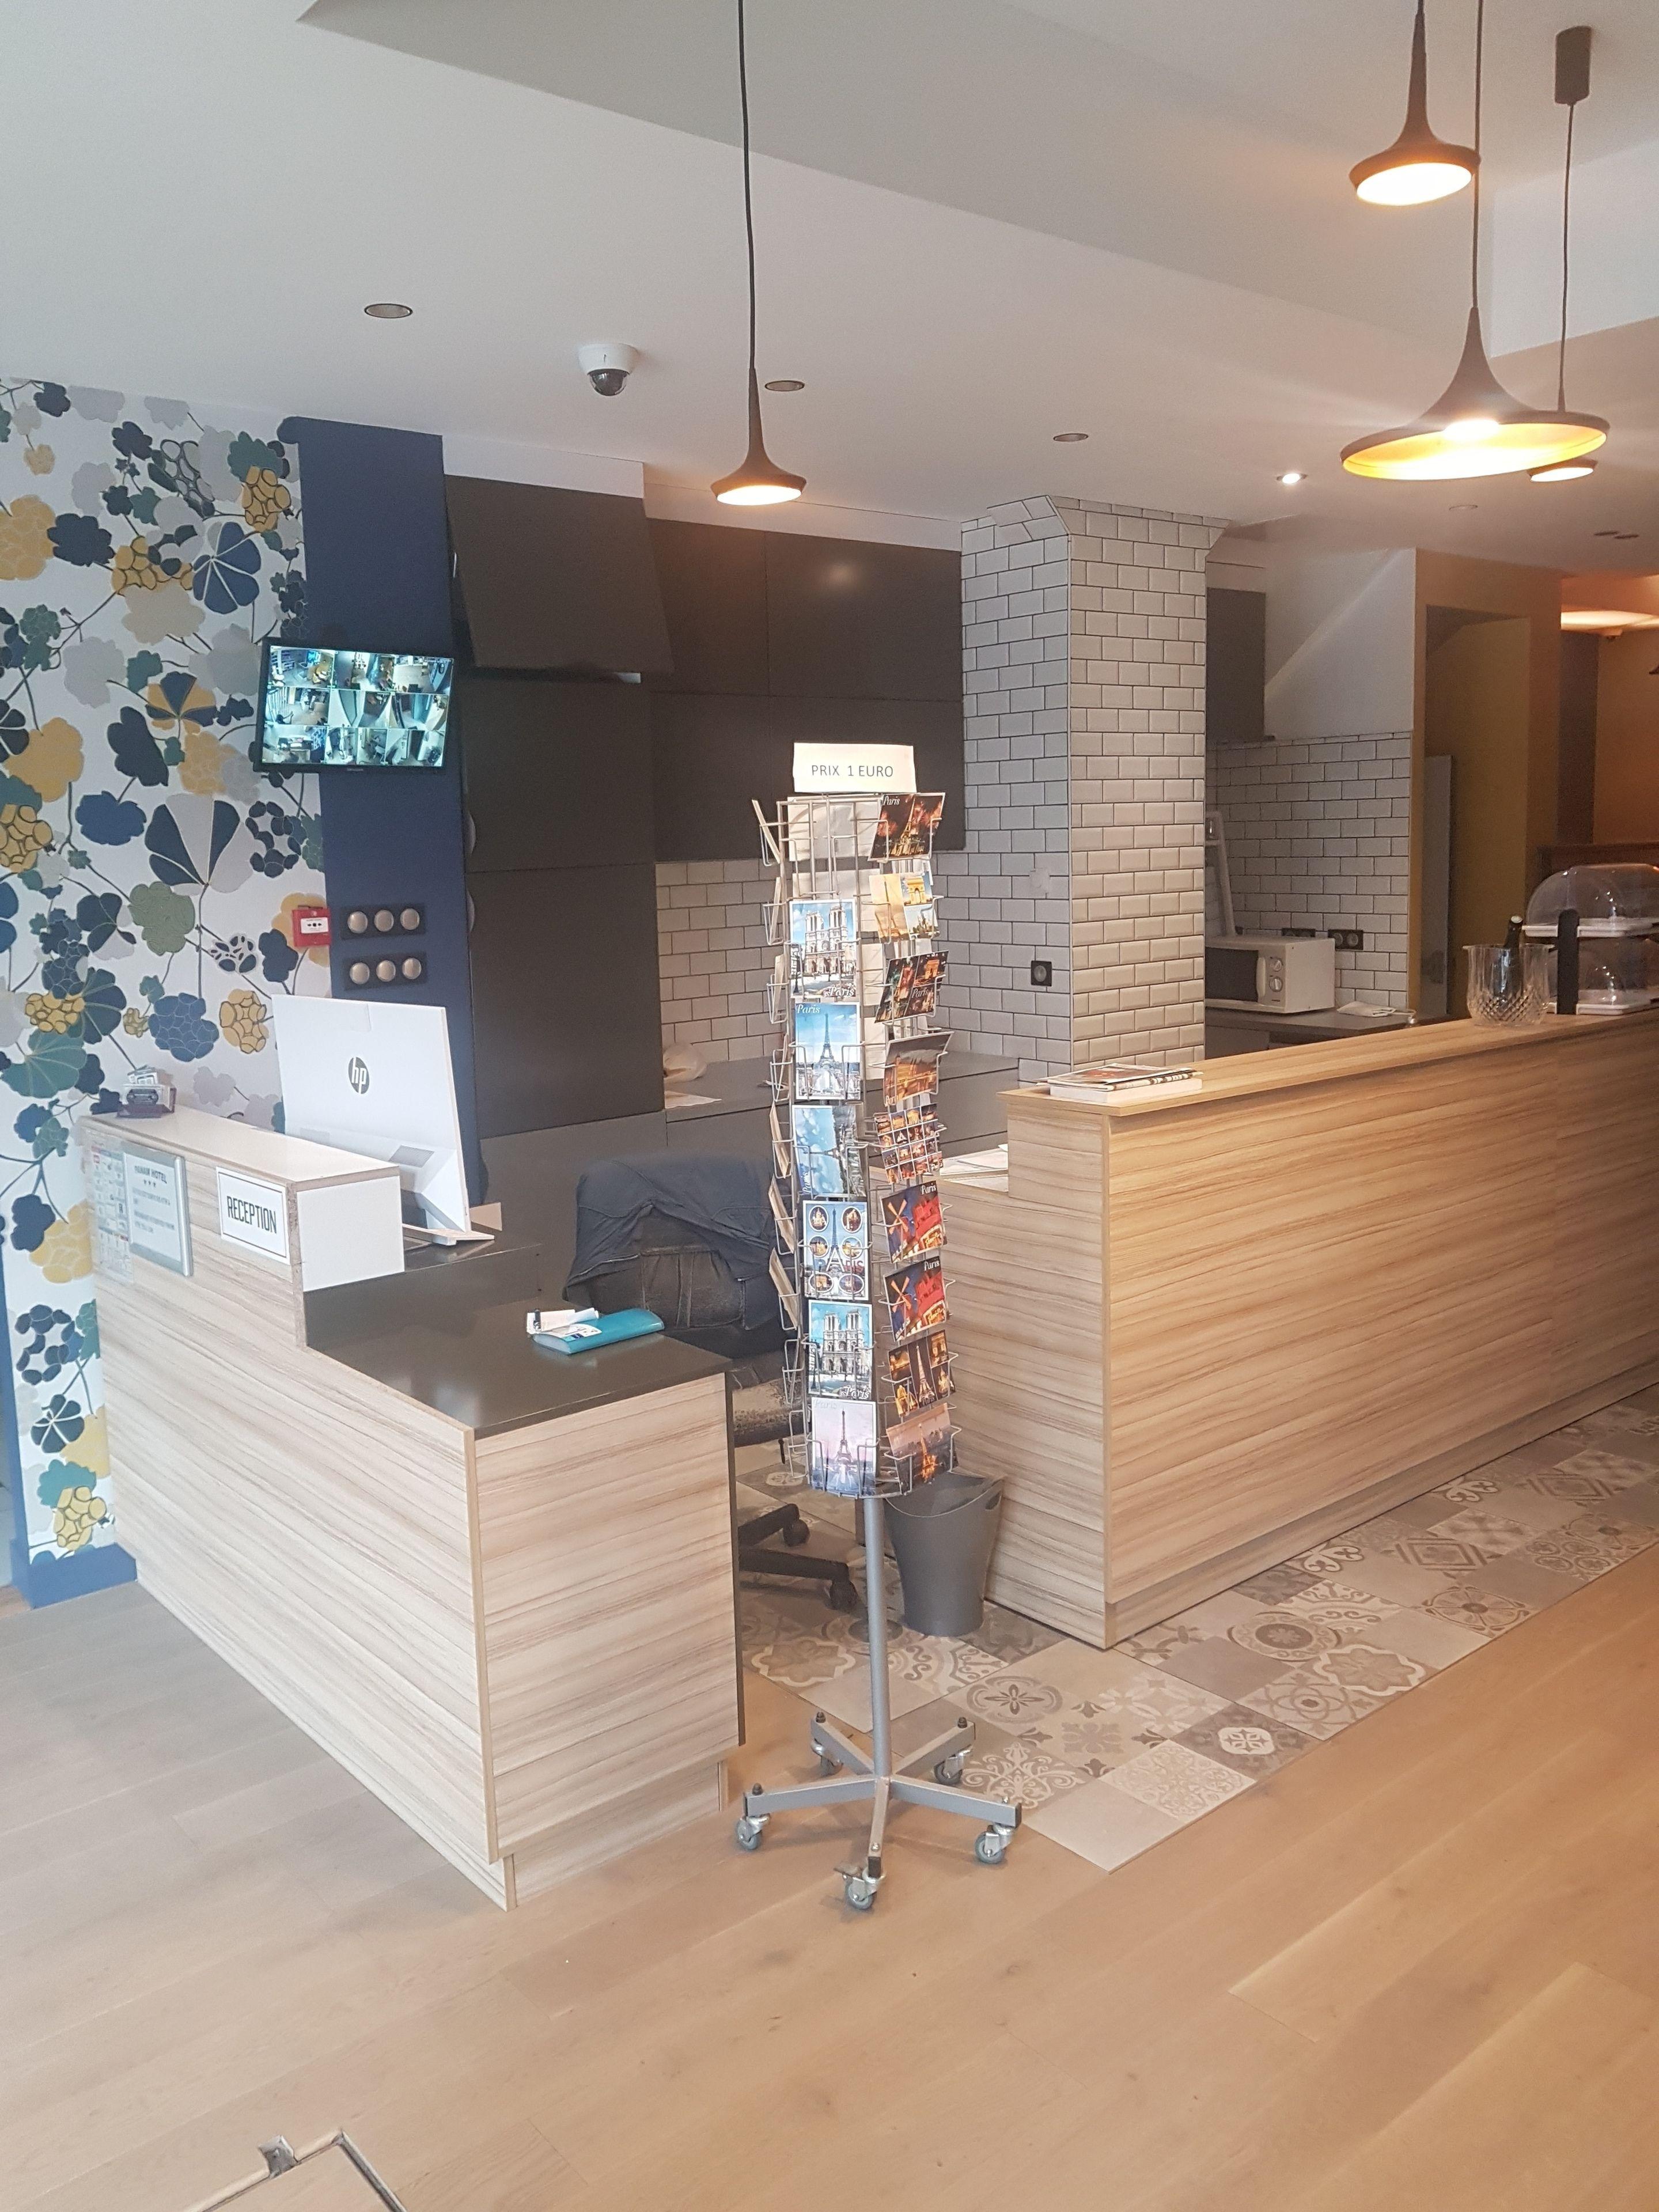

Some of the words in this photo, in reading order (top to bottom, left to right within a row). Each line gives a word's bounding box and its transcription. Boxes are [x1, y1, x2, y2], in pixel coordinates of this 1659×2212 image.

[811, 764, 840, 777] PRIX
[847, 765, 853, 777] 1
[859, 766, 894, 777] EURO
[882, 796, 900, 806] Paris
[829, 984, 855, 997] Paris
[911, 988, 929, 998] Paris
[797, 1004, 820, 1014] Paris
[351, 1056, 367, 1095] hp
[921, 1183, 937, 1195] Paris
[227, 1195, 277, 1234] RECEPTION
[924, 1260, 940, 1271] Paris
[845, 1385, 870, 1399] Paris
[815, 1399, 838, 1410] Paris
